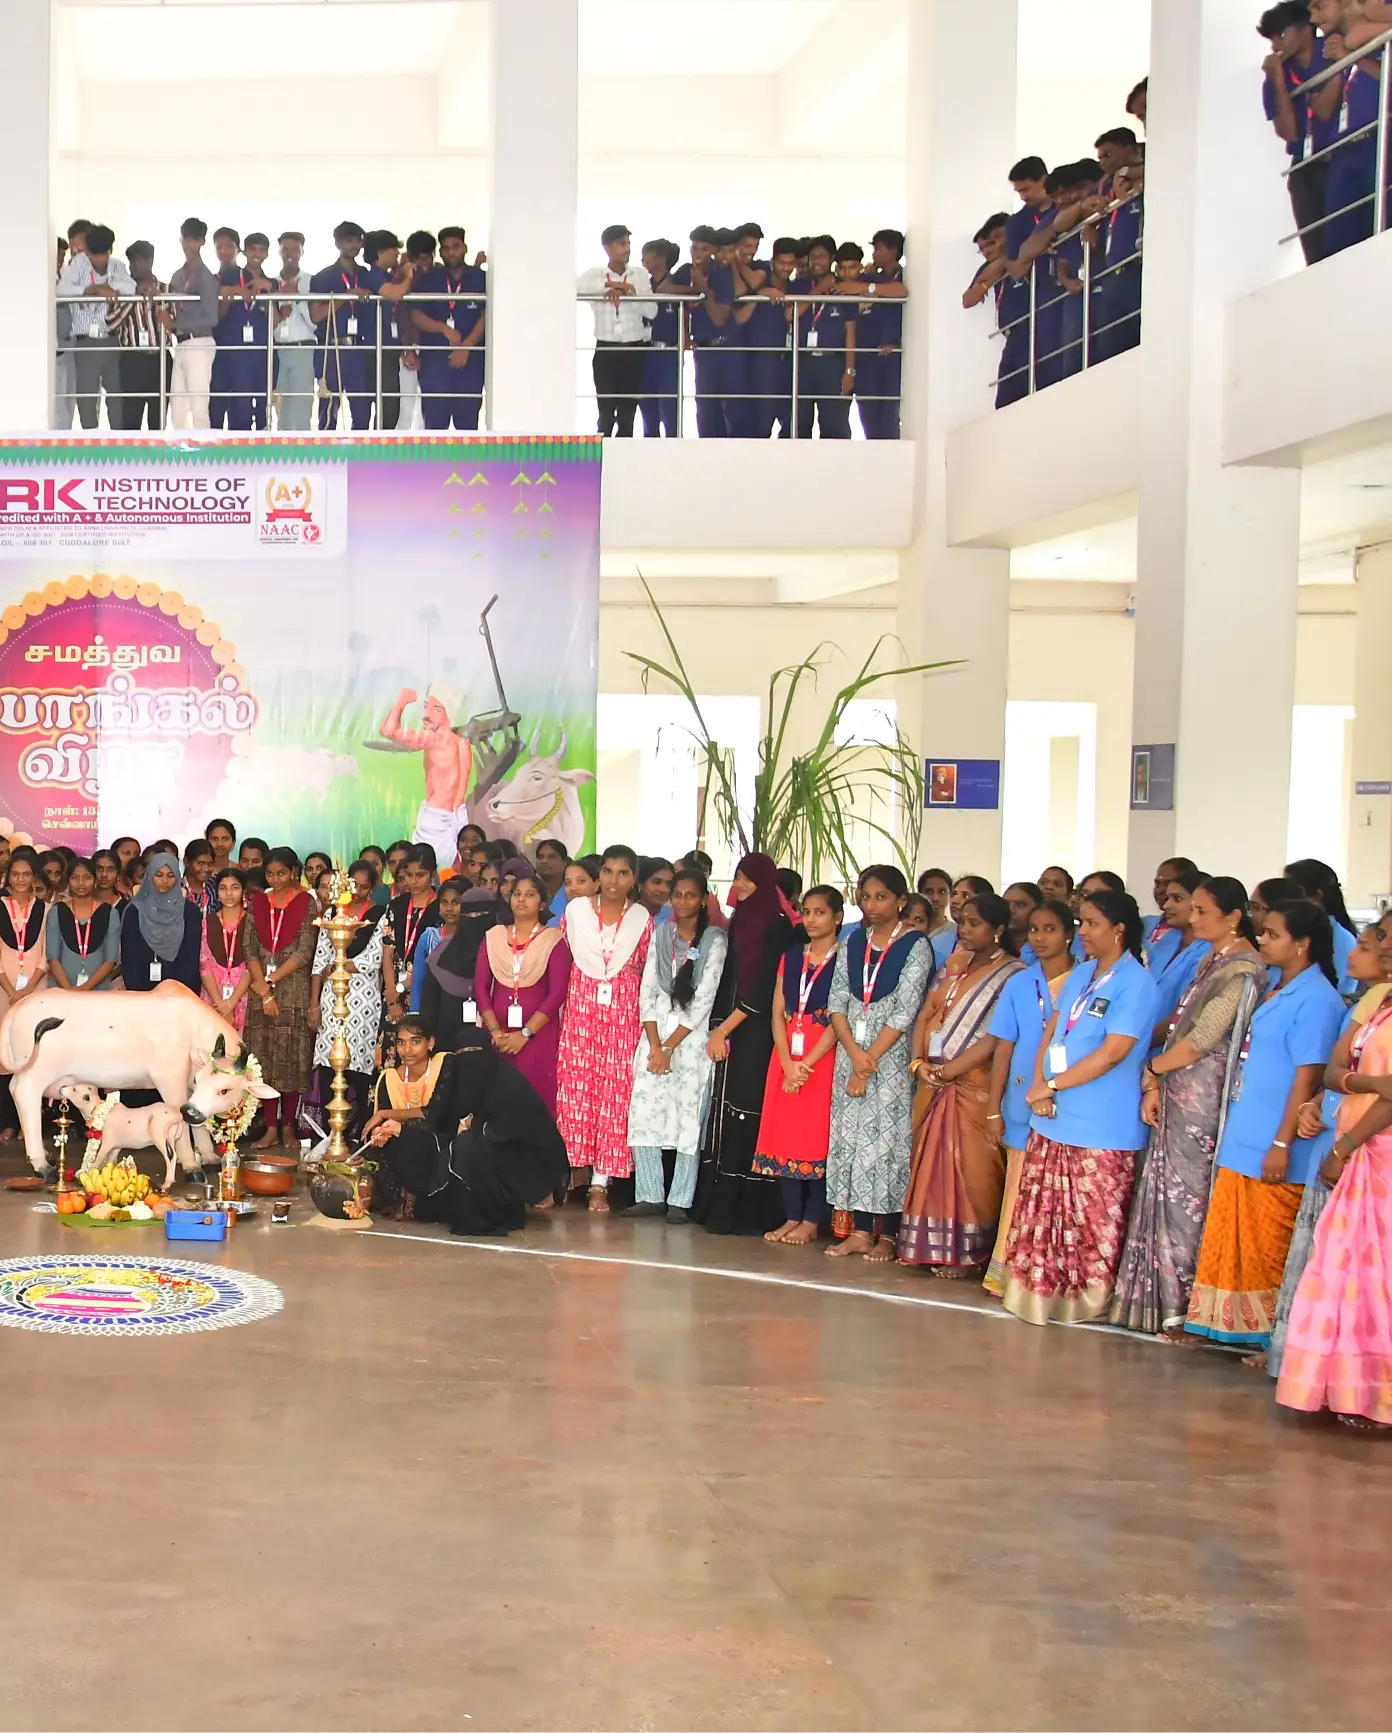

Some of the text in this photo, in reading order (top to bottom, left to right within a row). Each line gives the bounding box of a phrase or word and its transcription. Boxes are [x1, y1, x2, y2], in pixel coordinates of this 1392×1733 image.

[94, 478, 246, 492] INSTITUTE OF
[275, 483, 303, 501] A+
[93, 496, 250, 511] TECHNOLOGY
[42, 512, 70, 523] with
[72, 513, 82, 523] A
[94, 513, 103, 522] &
[106, 512, 183, 523] Autonomous
[186, 512, 249, 523] Institution
[260, 524, 299, 536] NAAC
[24, 634, 181, 671] சமத்துவ
